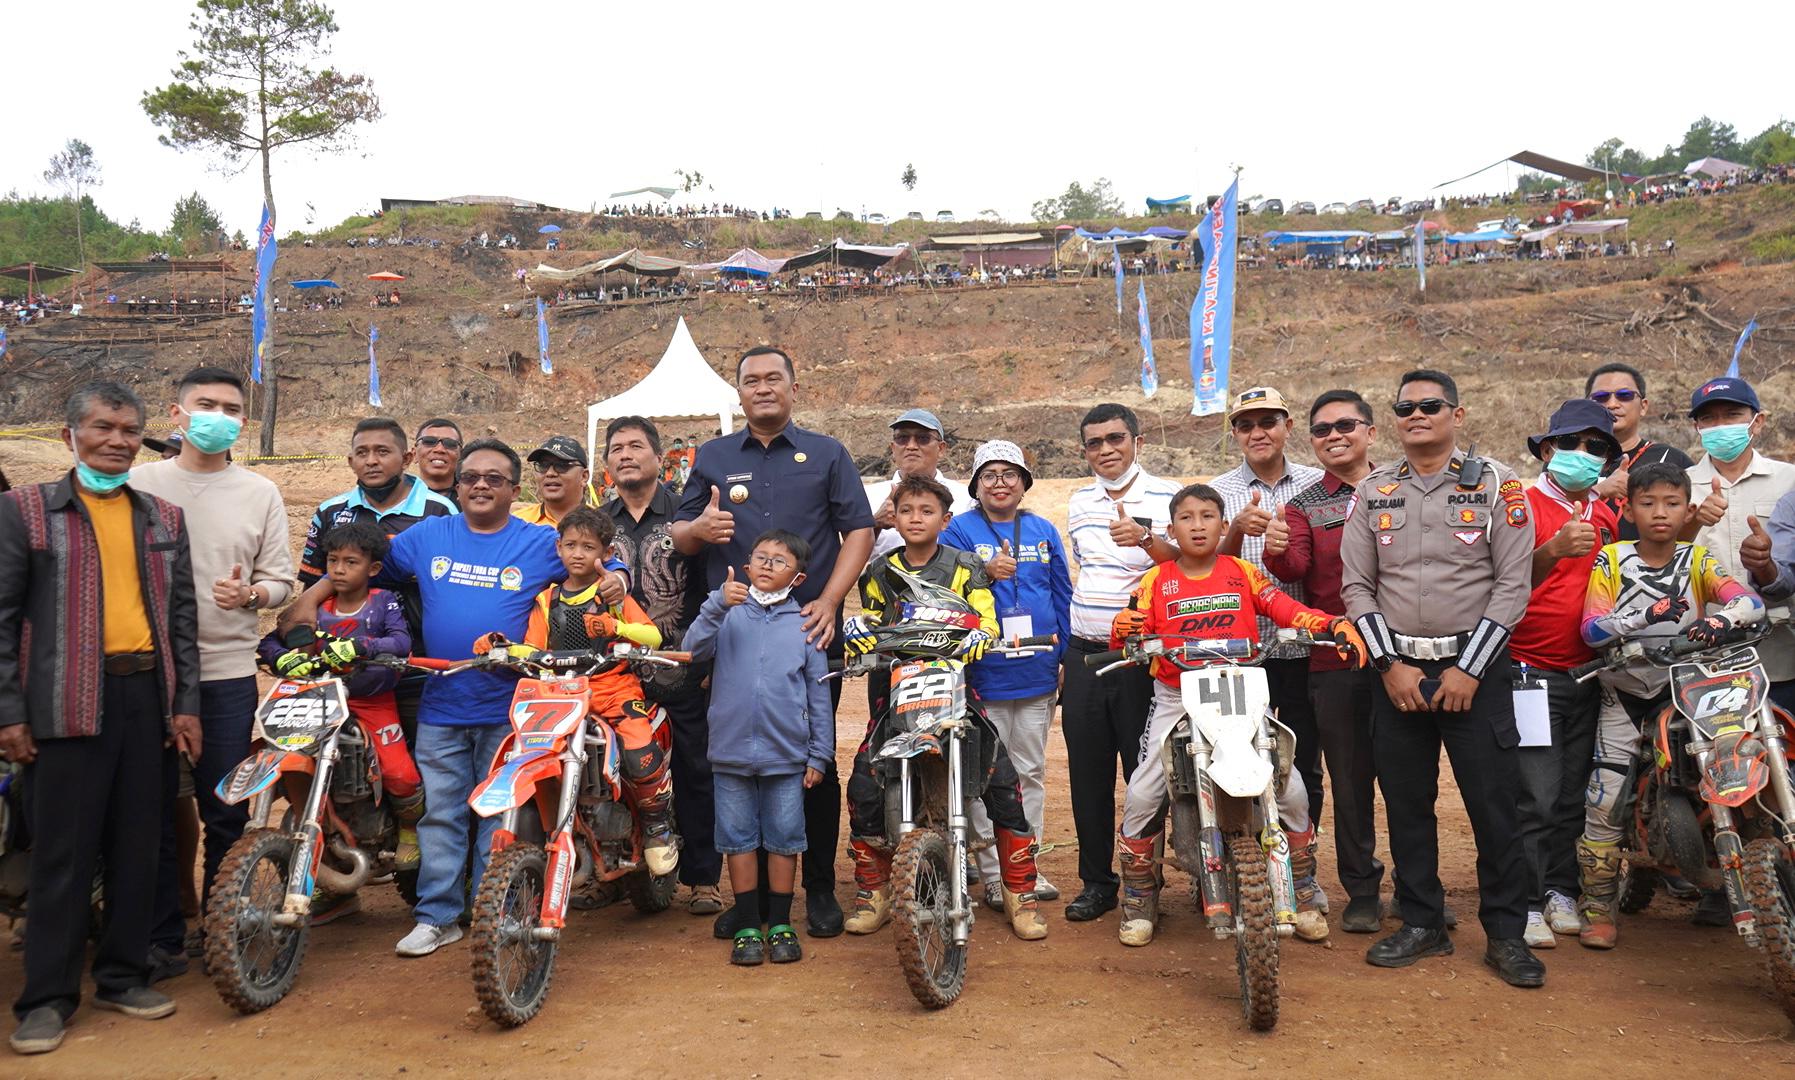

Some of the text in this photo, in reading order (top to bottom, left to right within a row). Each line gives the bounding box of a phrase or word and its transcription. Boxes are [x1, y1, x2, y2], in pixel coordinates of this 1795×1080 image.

[1447, 493, 1488, 505] POLRI
[897, 673, 958, 706] 22
[1198, 674, 1247, 716] 41
[264, 698, 339, 726] 222
